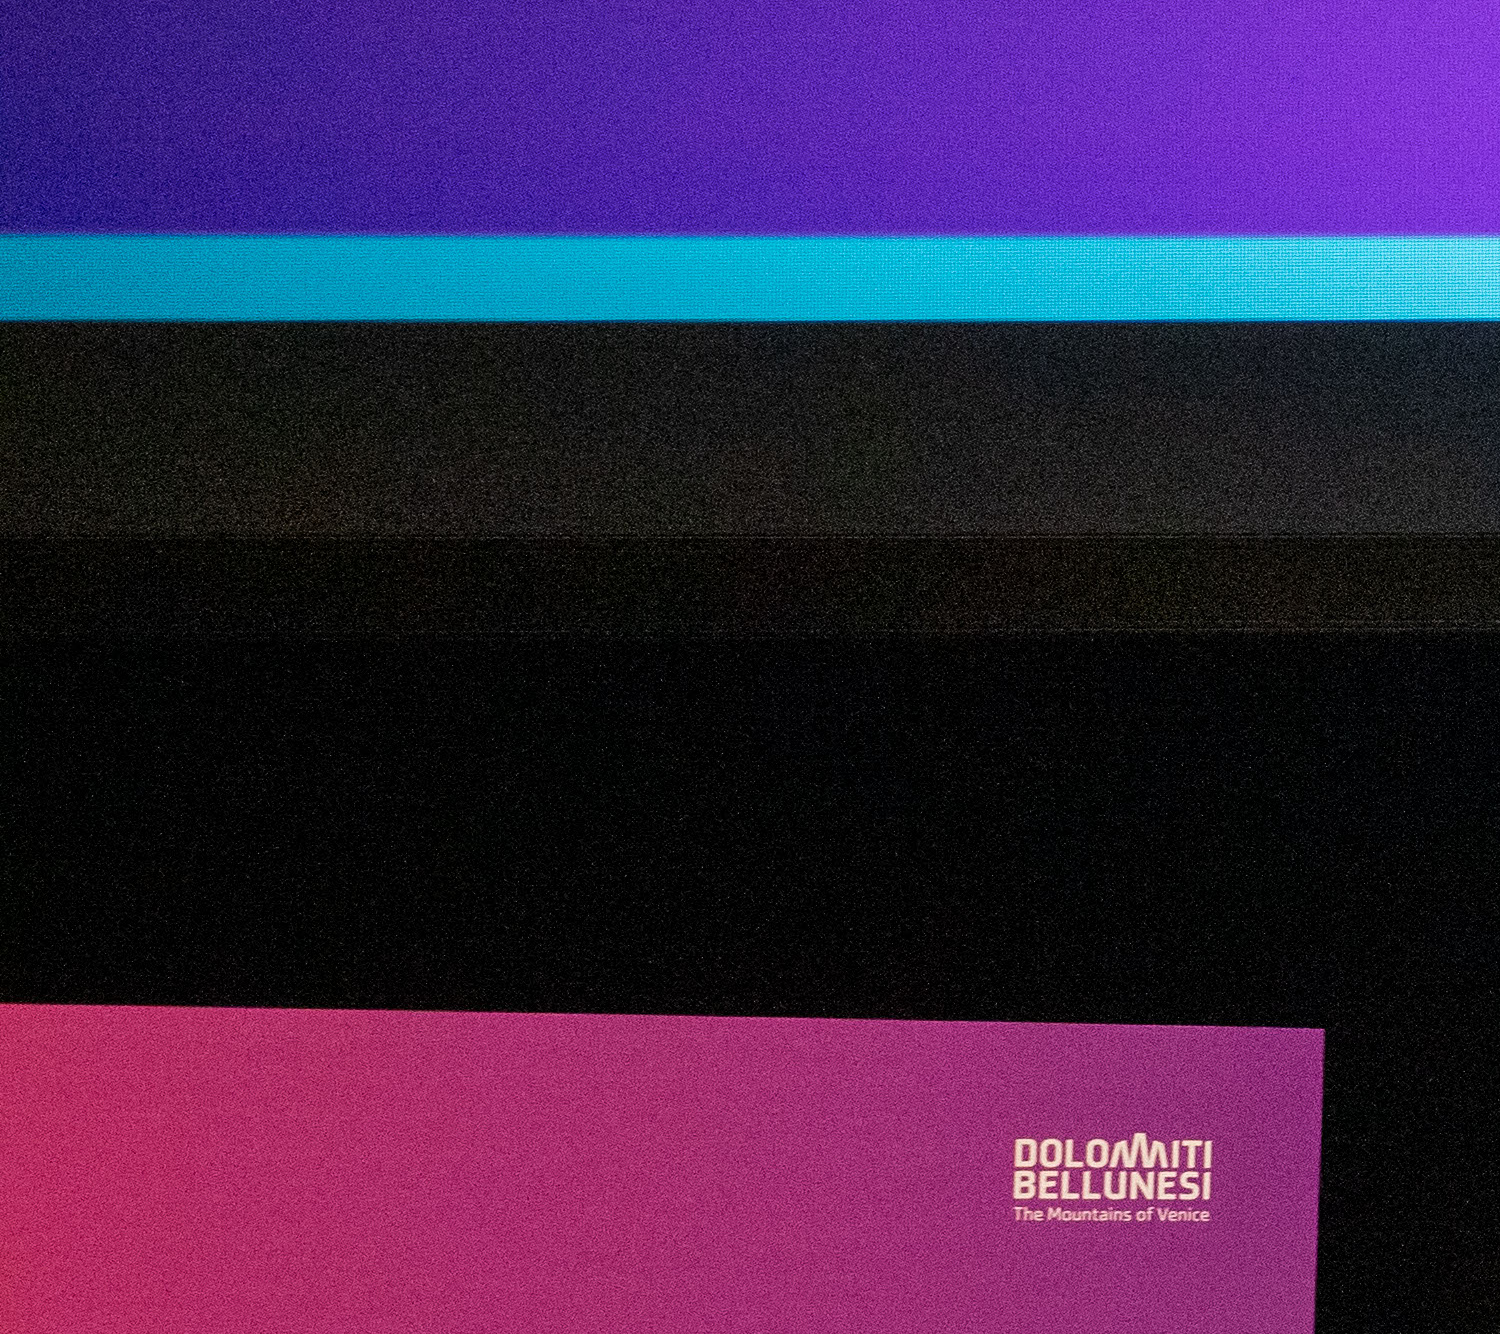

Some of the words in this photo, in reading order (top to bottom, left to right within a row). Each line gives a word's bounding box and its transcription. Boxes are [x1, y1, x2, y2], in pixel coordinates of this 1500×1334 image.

[1014, 1133, 1212, 1168] DOLOMITI
[1013, 1170, 1211, 1200] BELLUNESI
[1014, 1206, 1044, 1221] The
[1046, 1207, 1132, 1222] Mountains
[1136, 1207, 1155, 1222] of
[1157, 1208, 1211, 1222] Venice
